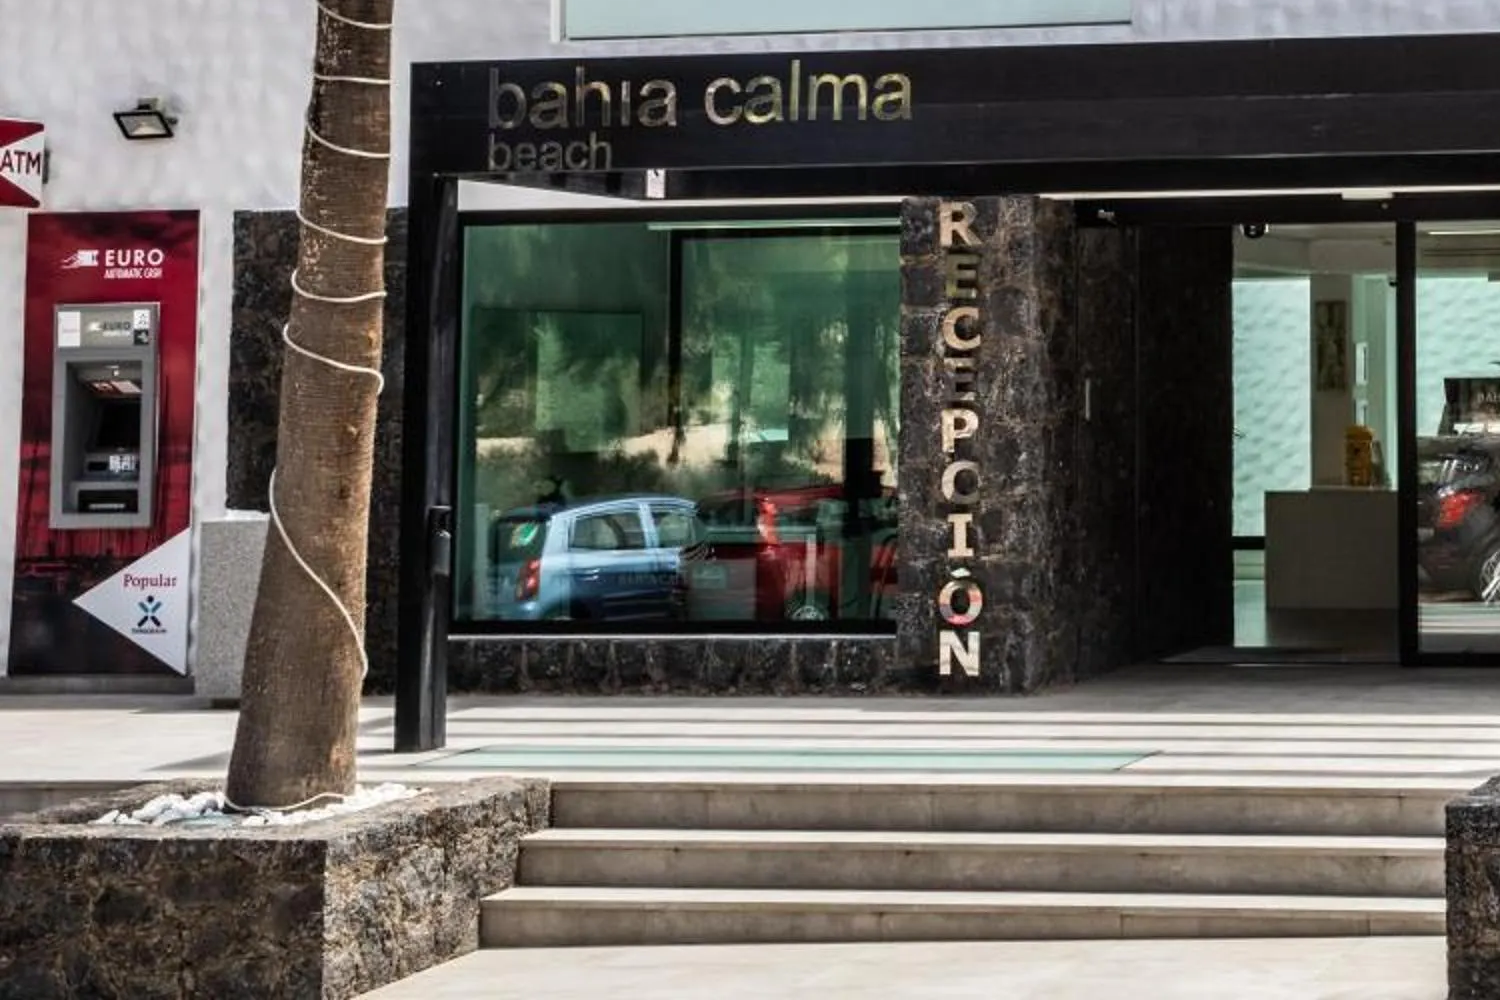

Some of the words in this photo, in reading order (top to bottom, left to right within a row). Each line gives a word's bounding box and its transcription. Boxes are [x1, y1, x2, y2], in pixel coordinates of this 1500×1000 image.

[705, 59, 913, 126] calma
[0, 149, 41, 175] ATM
[488, 131, 613, 171] beach
[105, 249, 164, 267] EURO
[938, 201, 983, 677] RECEPCIÓN
[123, 574, 177, 590] Popular
